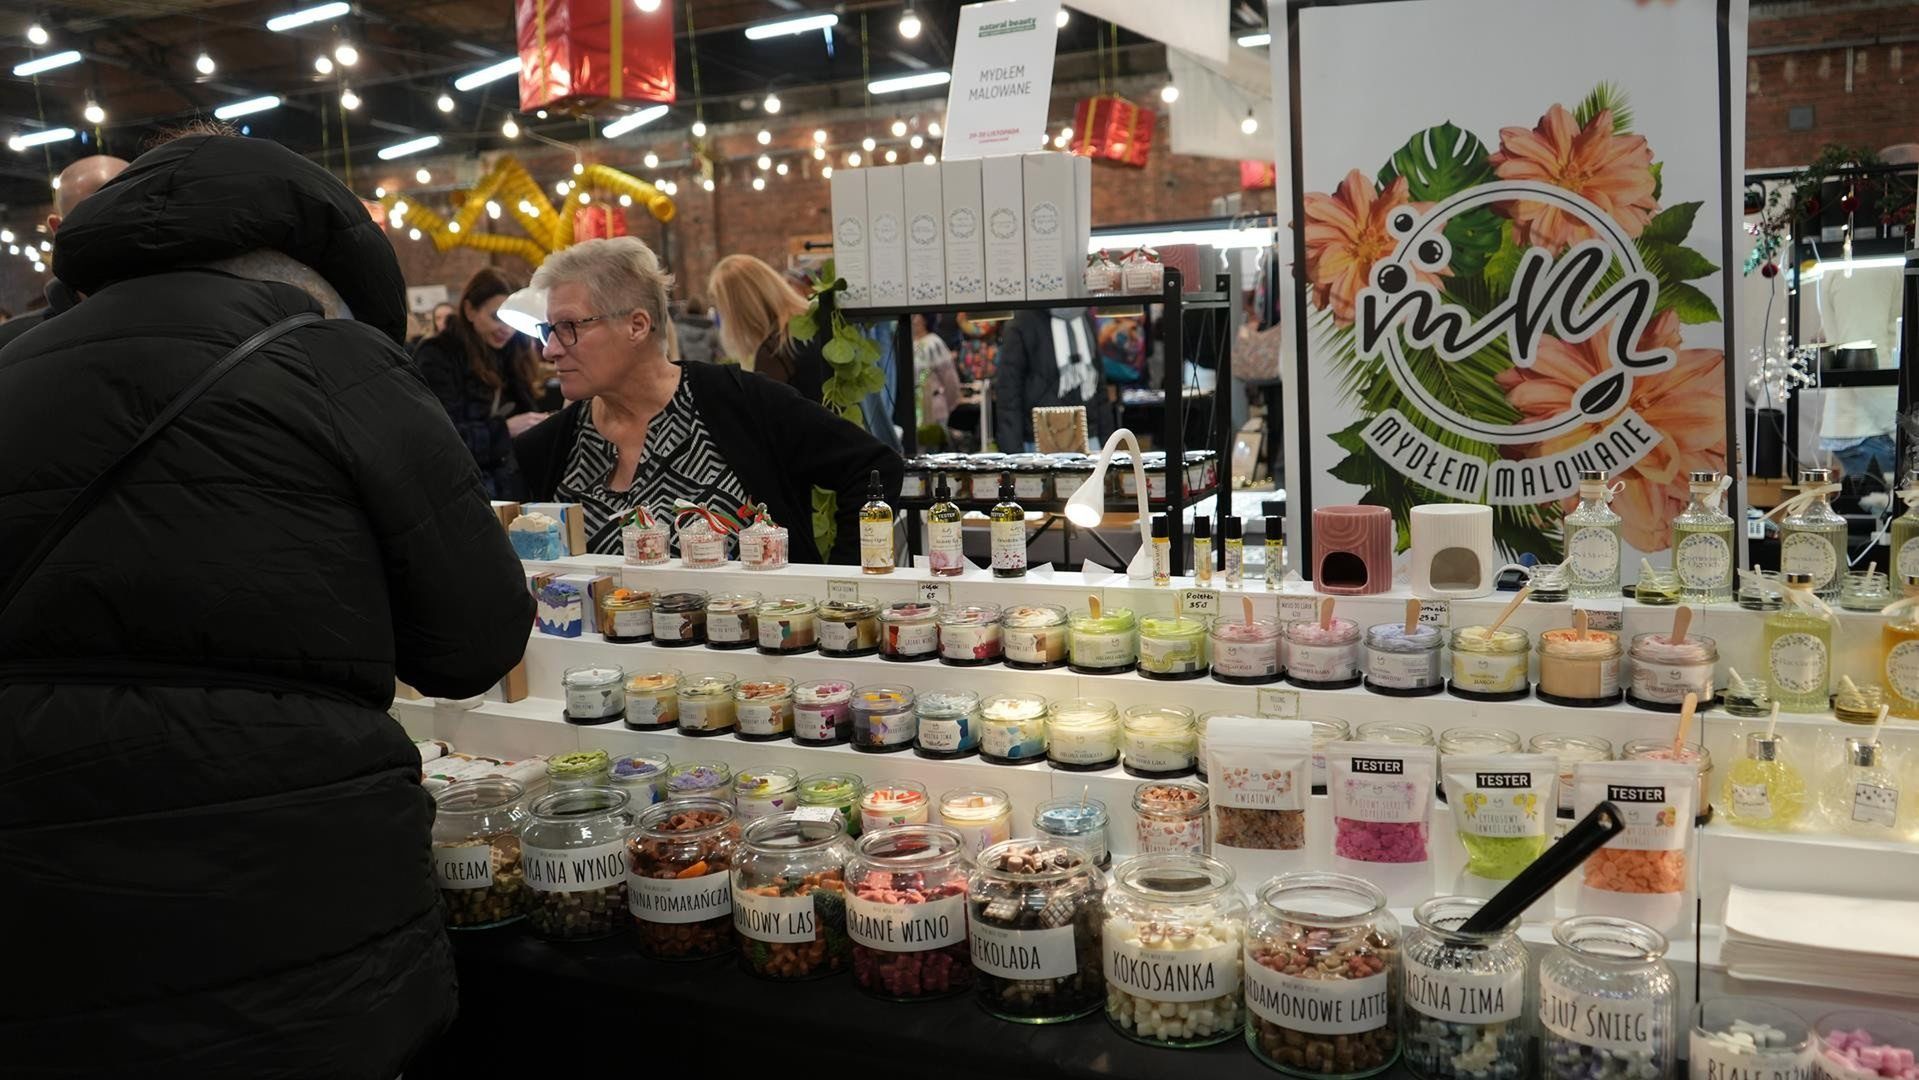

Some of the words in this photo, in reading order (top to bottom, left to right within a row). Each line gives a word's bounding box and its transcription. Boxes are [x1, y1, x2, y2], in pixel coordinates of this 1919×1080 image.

[980, 65, 1025, 82] MYDŁEM
[968, 81, 1032, 101] MALOWANE
[1370, 416, 1480, 494] MYDŁEM
[1495, 418, 1651, 497] MALOWANE
[1354, 759, 1401, 772] TESTER
[1479, 775, 1529, 787] TESTER
[1235, 793, 1276, 805] KWIATOWA
[1611, 787, 1663, 801] TESTER
[444, 860, 489, 881] CREAM
[545, 860, 567, 884] NA
[573, 851, 625, 884] WYNOS
[654, 887, 729, 913] POMARAŃCZA
[788, 910, 813, 935] LAS
[901, 915, 949, 943] WINO
[1113, 950, 1215, 993] KOKOSANKA
[1351, 991, 1387, 1022] LATTE
[1459, 987, 1505, 1014] ZIMA
[1551, 995, 1577, 1033] JUŻ
[1586, 1004, 1648, 1043] ŚNIEG
